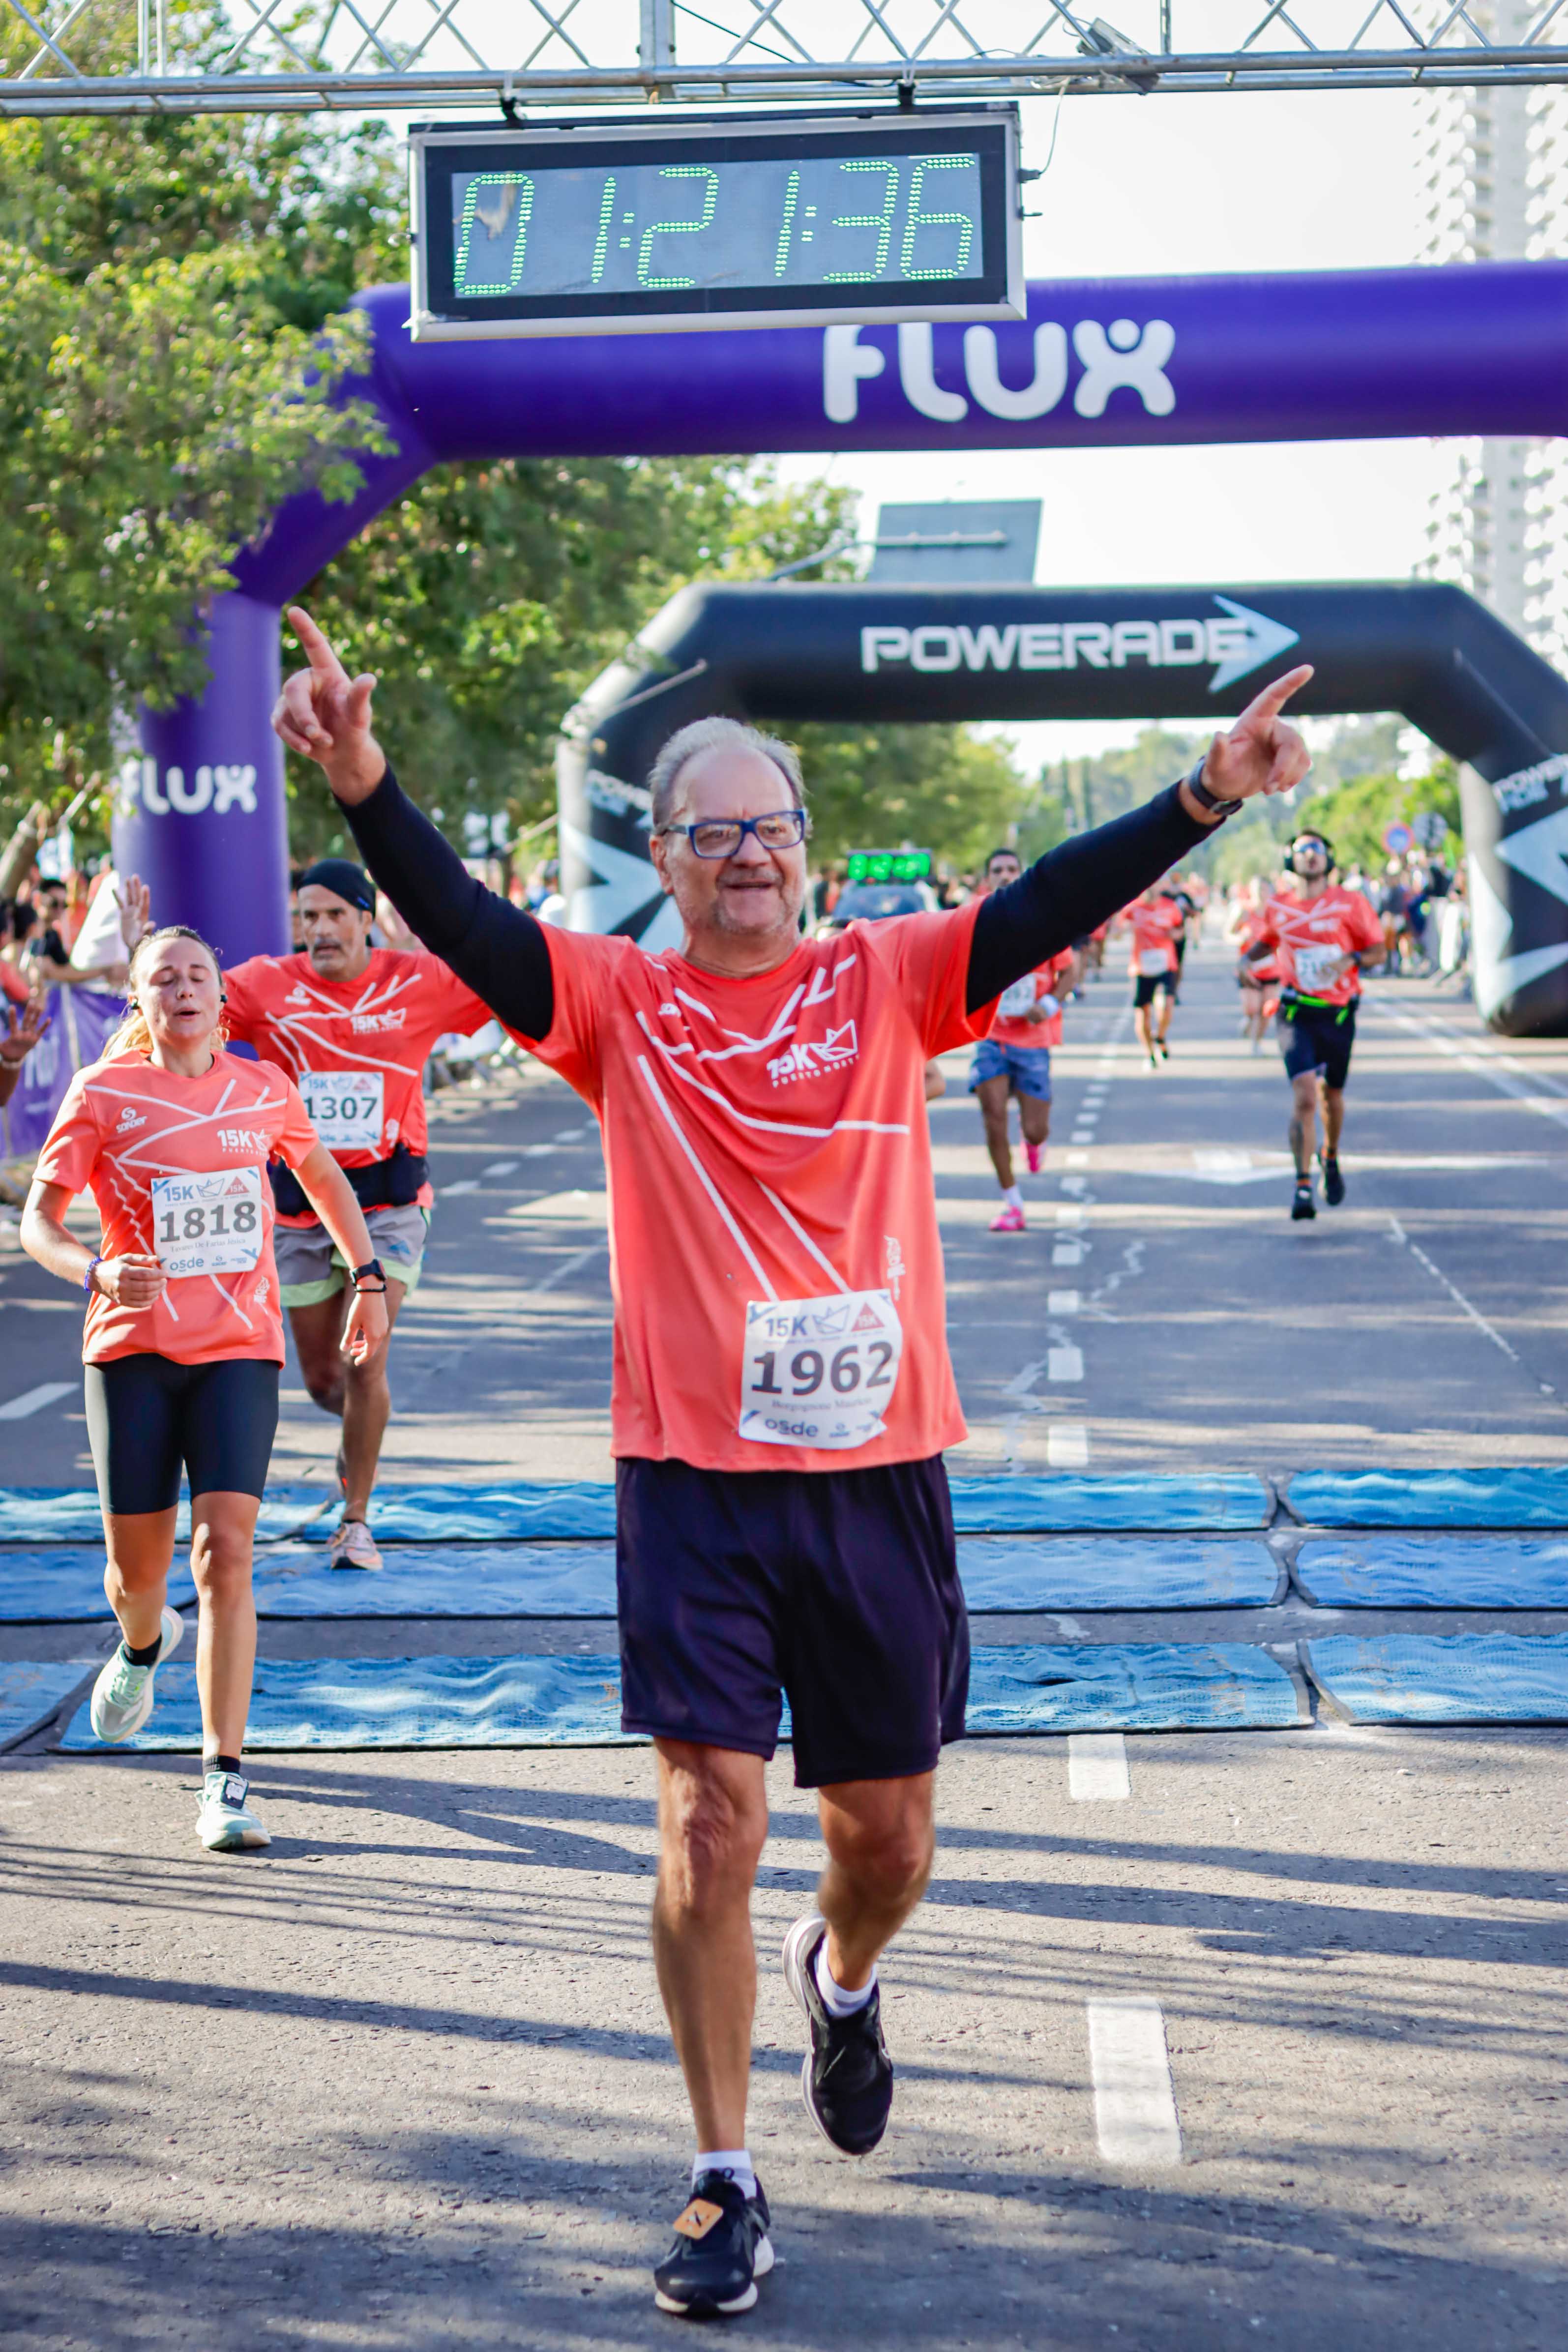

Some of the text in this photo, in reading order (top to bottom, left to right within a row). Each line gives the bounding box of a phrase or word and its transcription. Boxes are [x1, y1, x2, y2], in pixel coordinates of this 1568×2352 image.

[861, 617, 1251, 673] POWERADE
[303, 1096, 378, 1120] 1307
[217, 1129, 253, 1148] 15K
[163, 1185, 194, 1202] 15K
[160, 1201, 257, 1243] 1818
[170, 1257, 205, 1272] osde
[766, 1315, 808, 1337] 15K
[751, 1341, 893, 1396] 1962
[765, 1418, 819, 1438] osde
